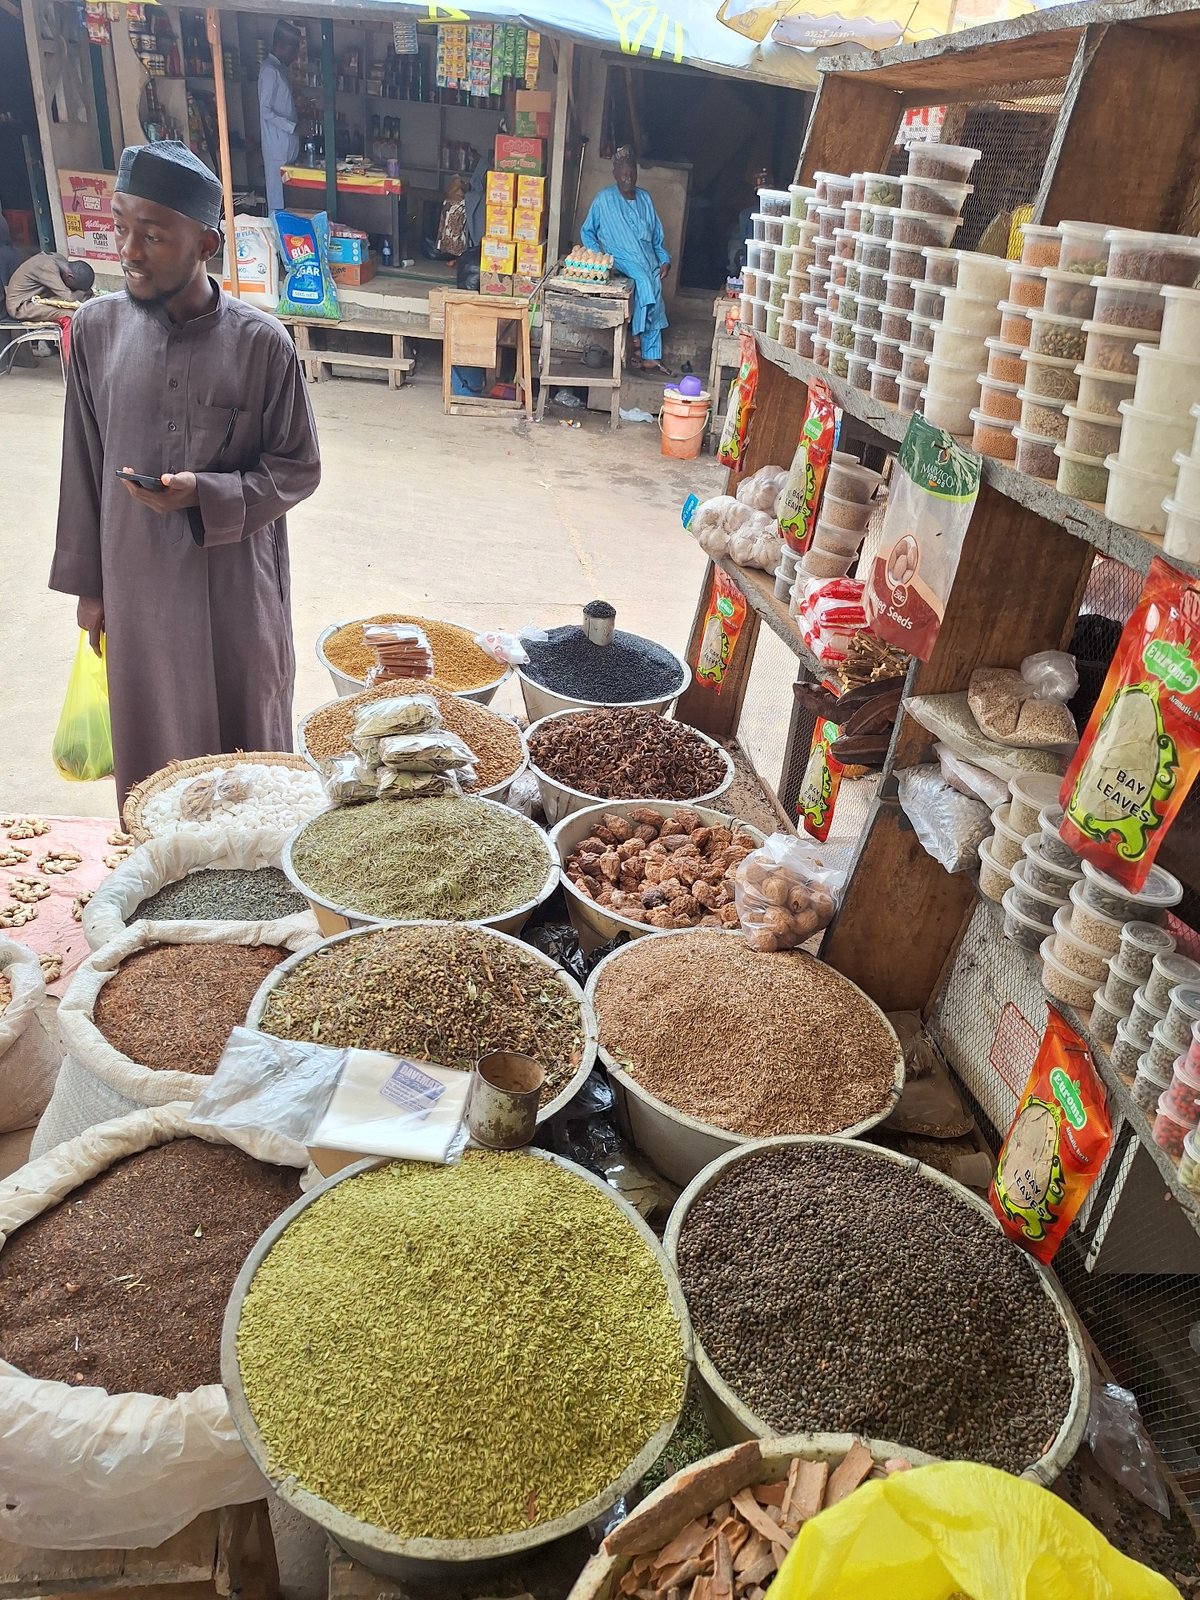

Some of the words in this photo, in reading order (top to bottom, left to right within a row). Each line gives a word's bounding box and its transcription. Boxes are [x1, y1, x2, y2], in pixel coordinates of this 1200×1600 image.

[93, 232, 108, 240] CORN
[291, 244, 311, 258] BUA
[784, 498, 807, 516] LEAVES
[887, 606, 914, 630] Seeds
[1146, 644, 1194, 688] Euroma
[1168, 695, 1192, 717] Aromatic
[1116, 769, 1146, 796] BAY
[1096, 778, 1151, 823] LEAVES
[1053, 1072, 1084, 1126] Euroma
[1013, 1169, 1046, 1218] LEAVES
[1024, 1169, 1041, 1195] BAY
